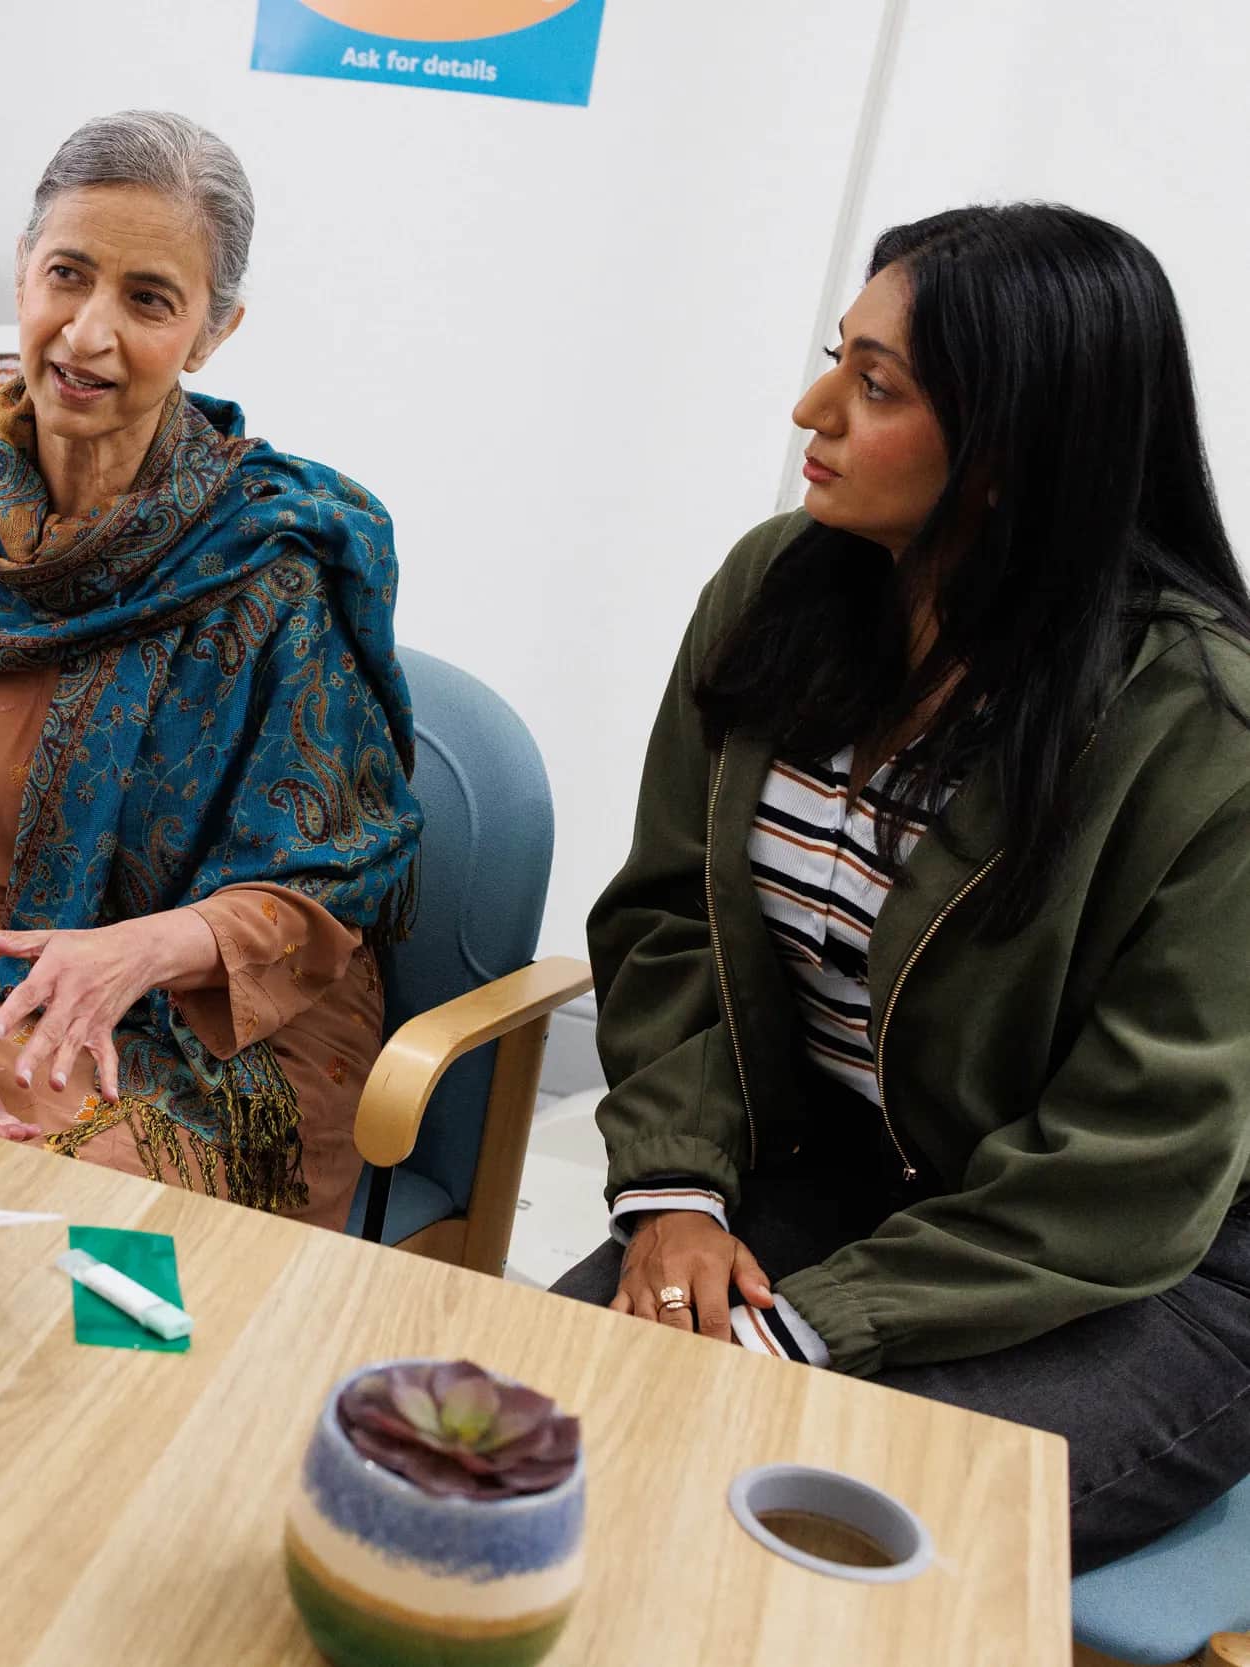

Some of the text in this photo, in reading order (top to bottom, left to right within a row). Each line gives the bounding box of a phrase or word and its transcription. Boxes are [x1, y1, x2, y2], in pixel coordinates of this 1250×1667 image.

[341, 47, 497, 81] Ask for details
